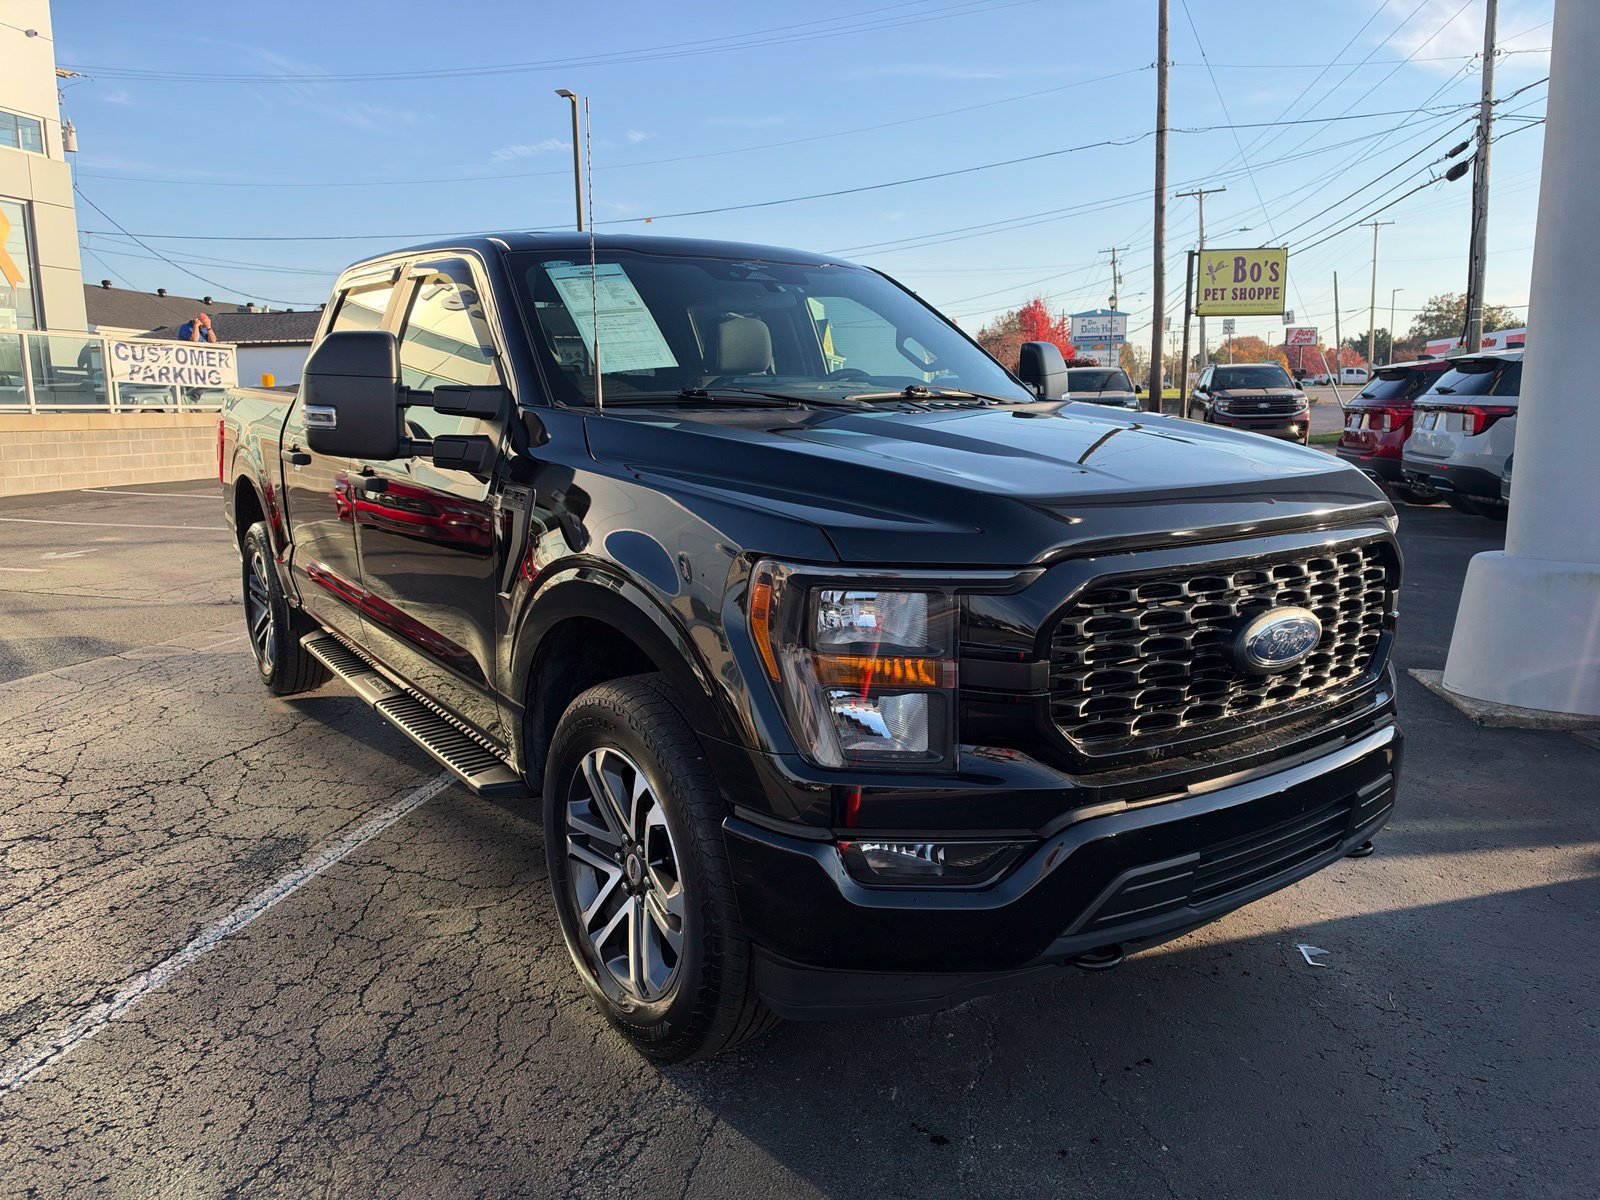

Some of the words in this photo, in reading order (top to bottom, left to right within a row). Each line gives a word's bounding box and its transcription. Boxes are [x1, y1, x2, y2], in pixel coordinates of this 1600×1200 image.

[1204, 288, 1227, 301] PET
[1231, 287, 1280, 301] SHOPPE
[1291, 336, 1312, 344] Zone
[1296, 329, 1315, 337] Auto
[114, 343, 231, 369] CUSTOMER
[129, 364, 222, 385] PARKING
[1267, 626, 1308, 655] Ford
